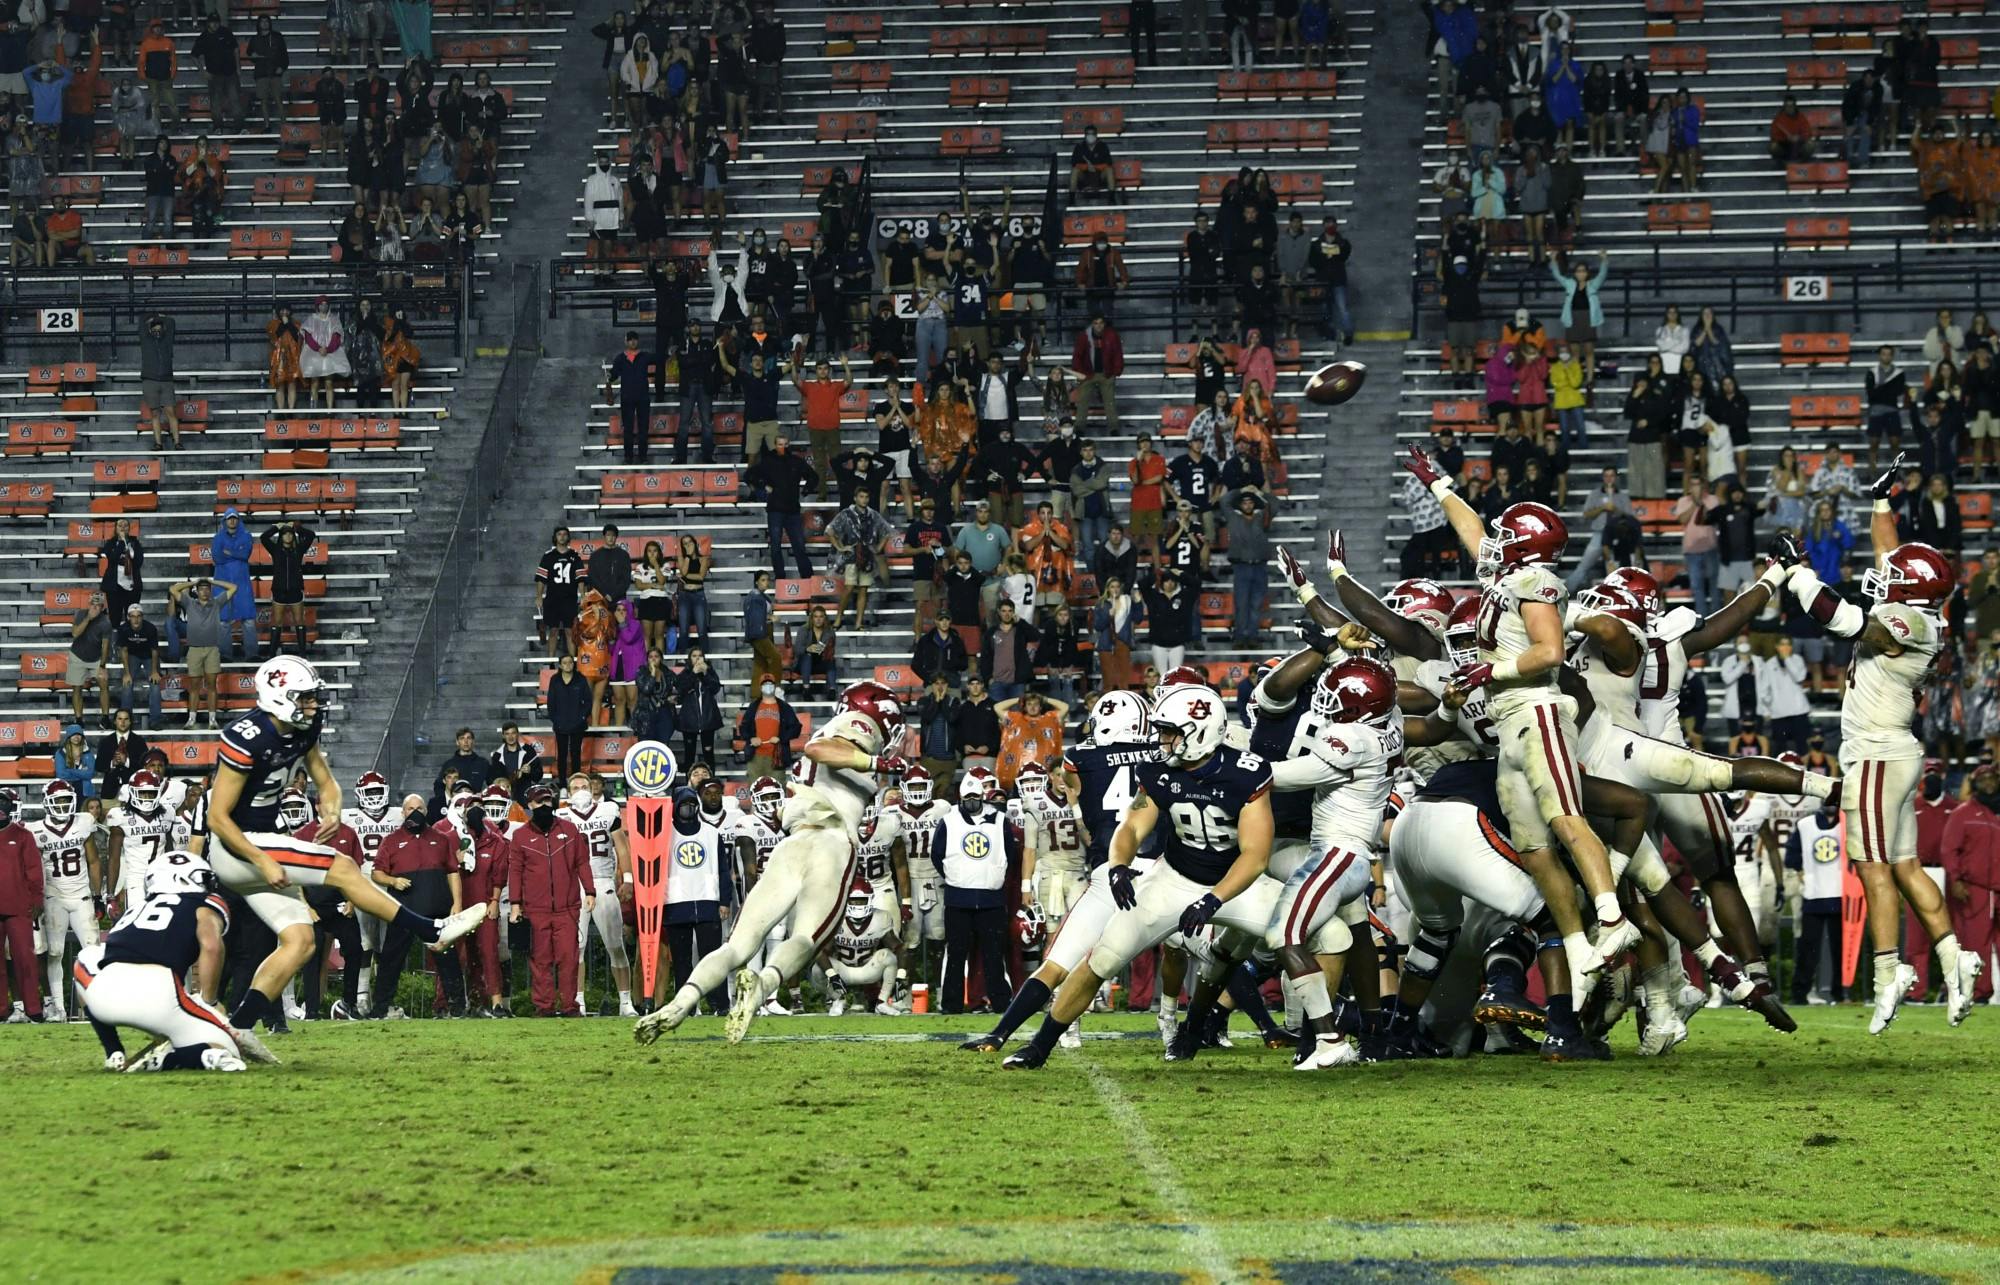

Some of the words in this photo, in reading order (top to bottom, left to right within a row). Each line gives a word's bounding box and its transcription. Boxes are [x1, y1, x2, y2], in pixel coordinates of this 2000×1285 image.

[961, 284, 981, 303] 34
[1795, 281, 1821, 297] 26
[47, 312, 73, 328] 28
[1192, 473, 1205, 494] 2
[1178, 542, 1191, 565] 2
[553, 562, 571, 583] 34
[1023, 583, 1033, 605] 2
[1643, 598, 1659, 611] 50
[231, 719, 261, 740] 26
[633, 749, 668, 785] SEC
[1236, 752, 1263, 772] 86
[1047, 819, 1080, 852] 13
[1169, 801, 1239, 852] 86
[142, 835, 160, 864] 7
[678, 842, 703, 867] SEC
[908, 830, 930, 858] 11
[965, 832, 989, 858] SEC
[50, 848, 81, 877] 18
